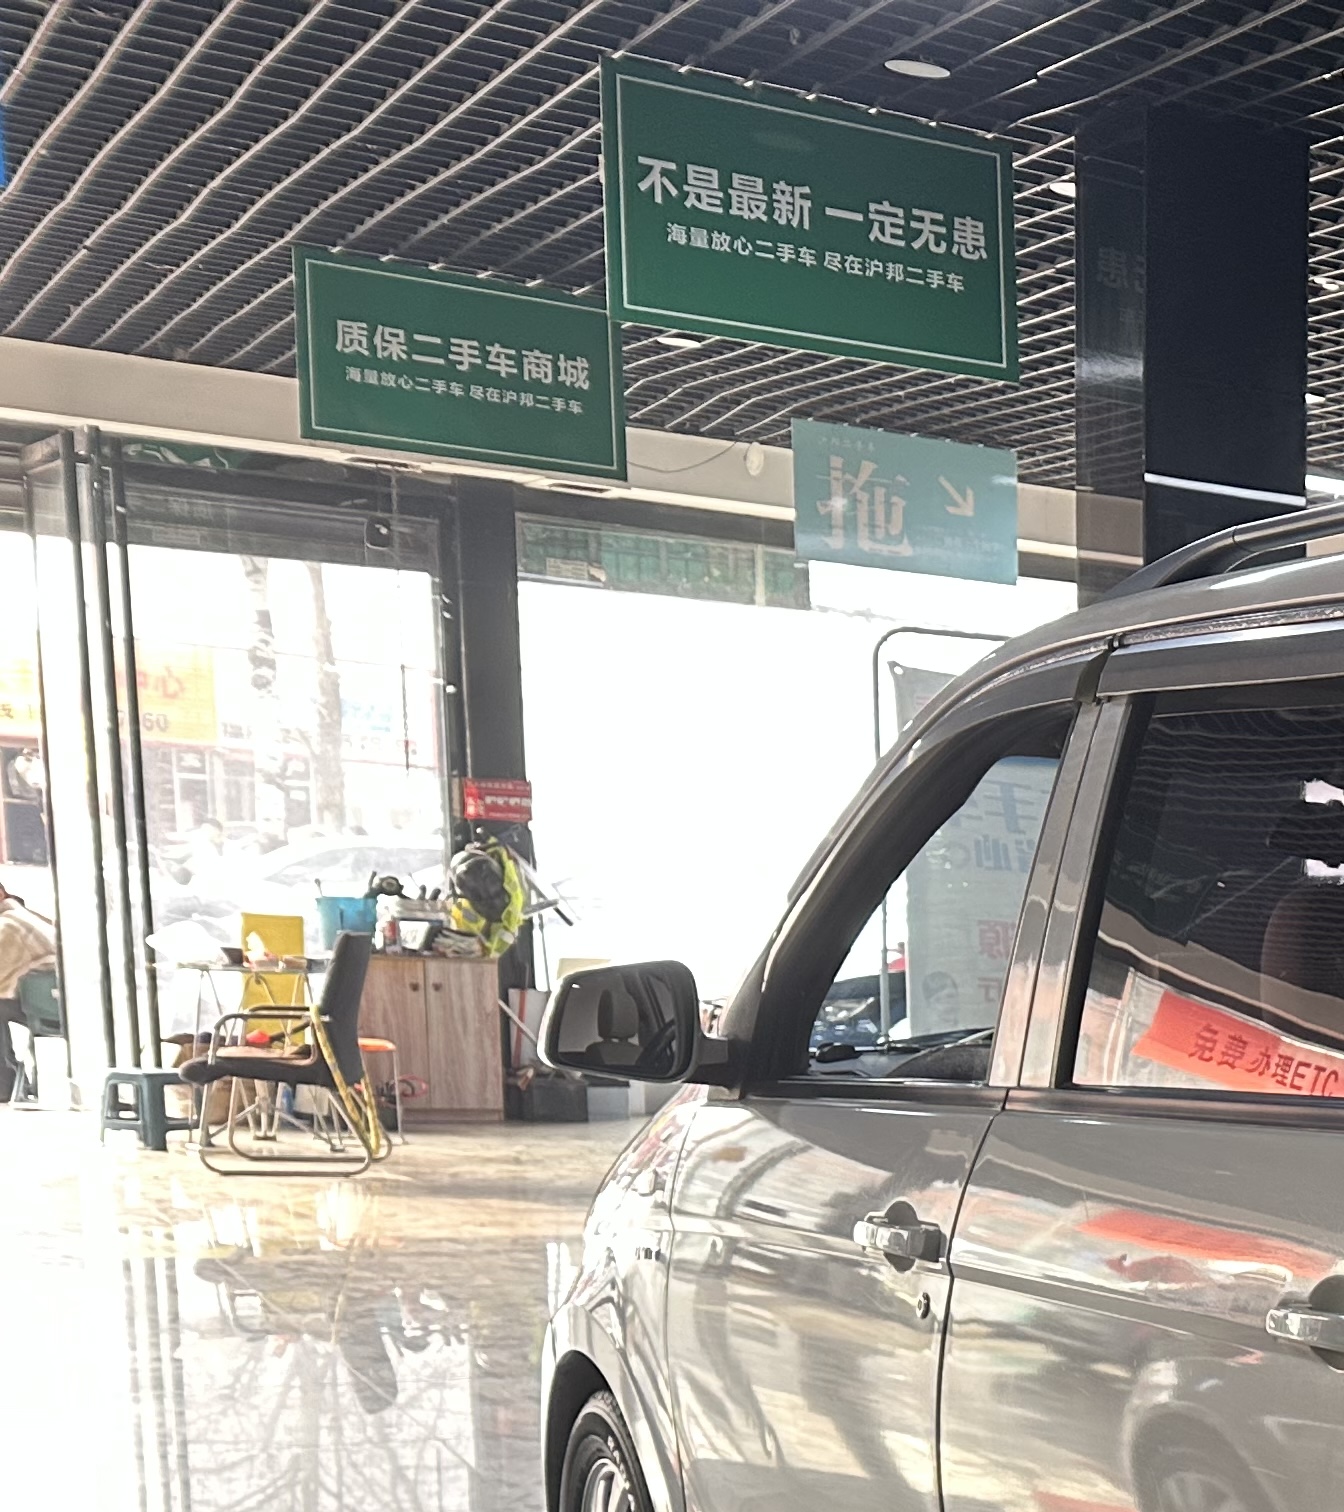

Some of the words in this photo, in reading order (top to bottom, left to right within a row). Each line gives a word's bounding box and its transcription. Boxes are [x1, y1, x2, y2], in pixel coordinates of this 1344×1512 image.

[637, 155, 812, 231] 不是最新
[825, 201, 989, 261] 一定无患
[666, 221, 818, 267] 海量放心二手车
[823, 251, 966, 293] 尽在沪邦二手车
[335, 319, 591, 391] 质保二手车商城
[345, 365, 466, 398] 海量放心二手车
[469, 385, 584, 415] 尽在沪邦二手车
